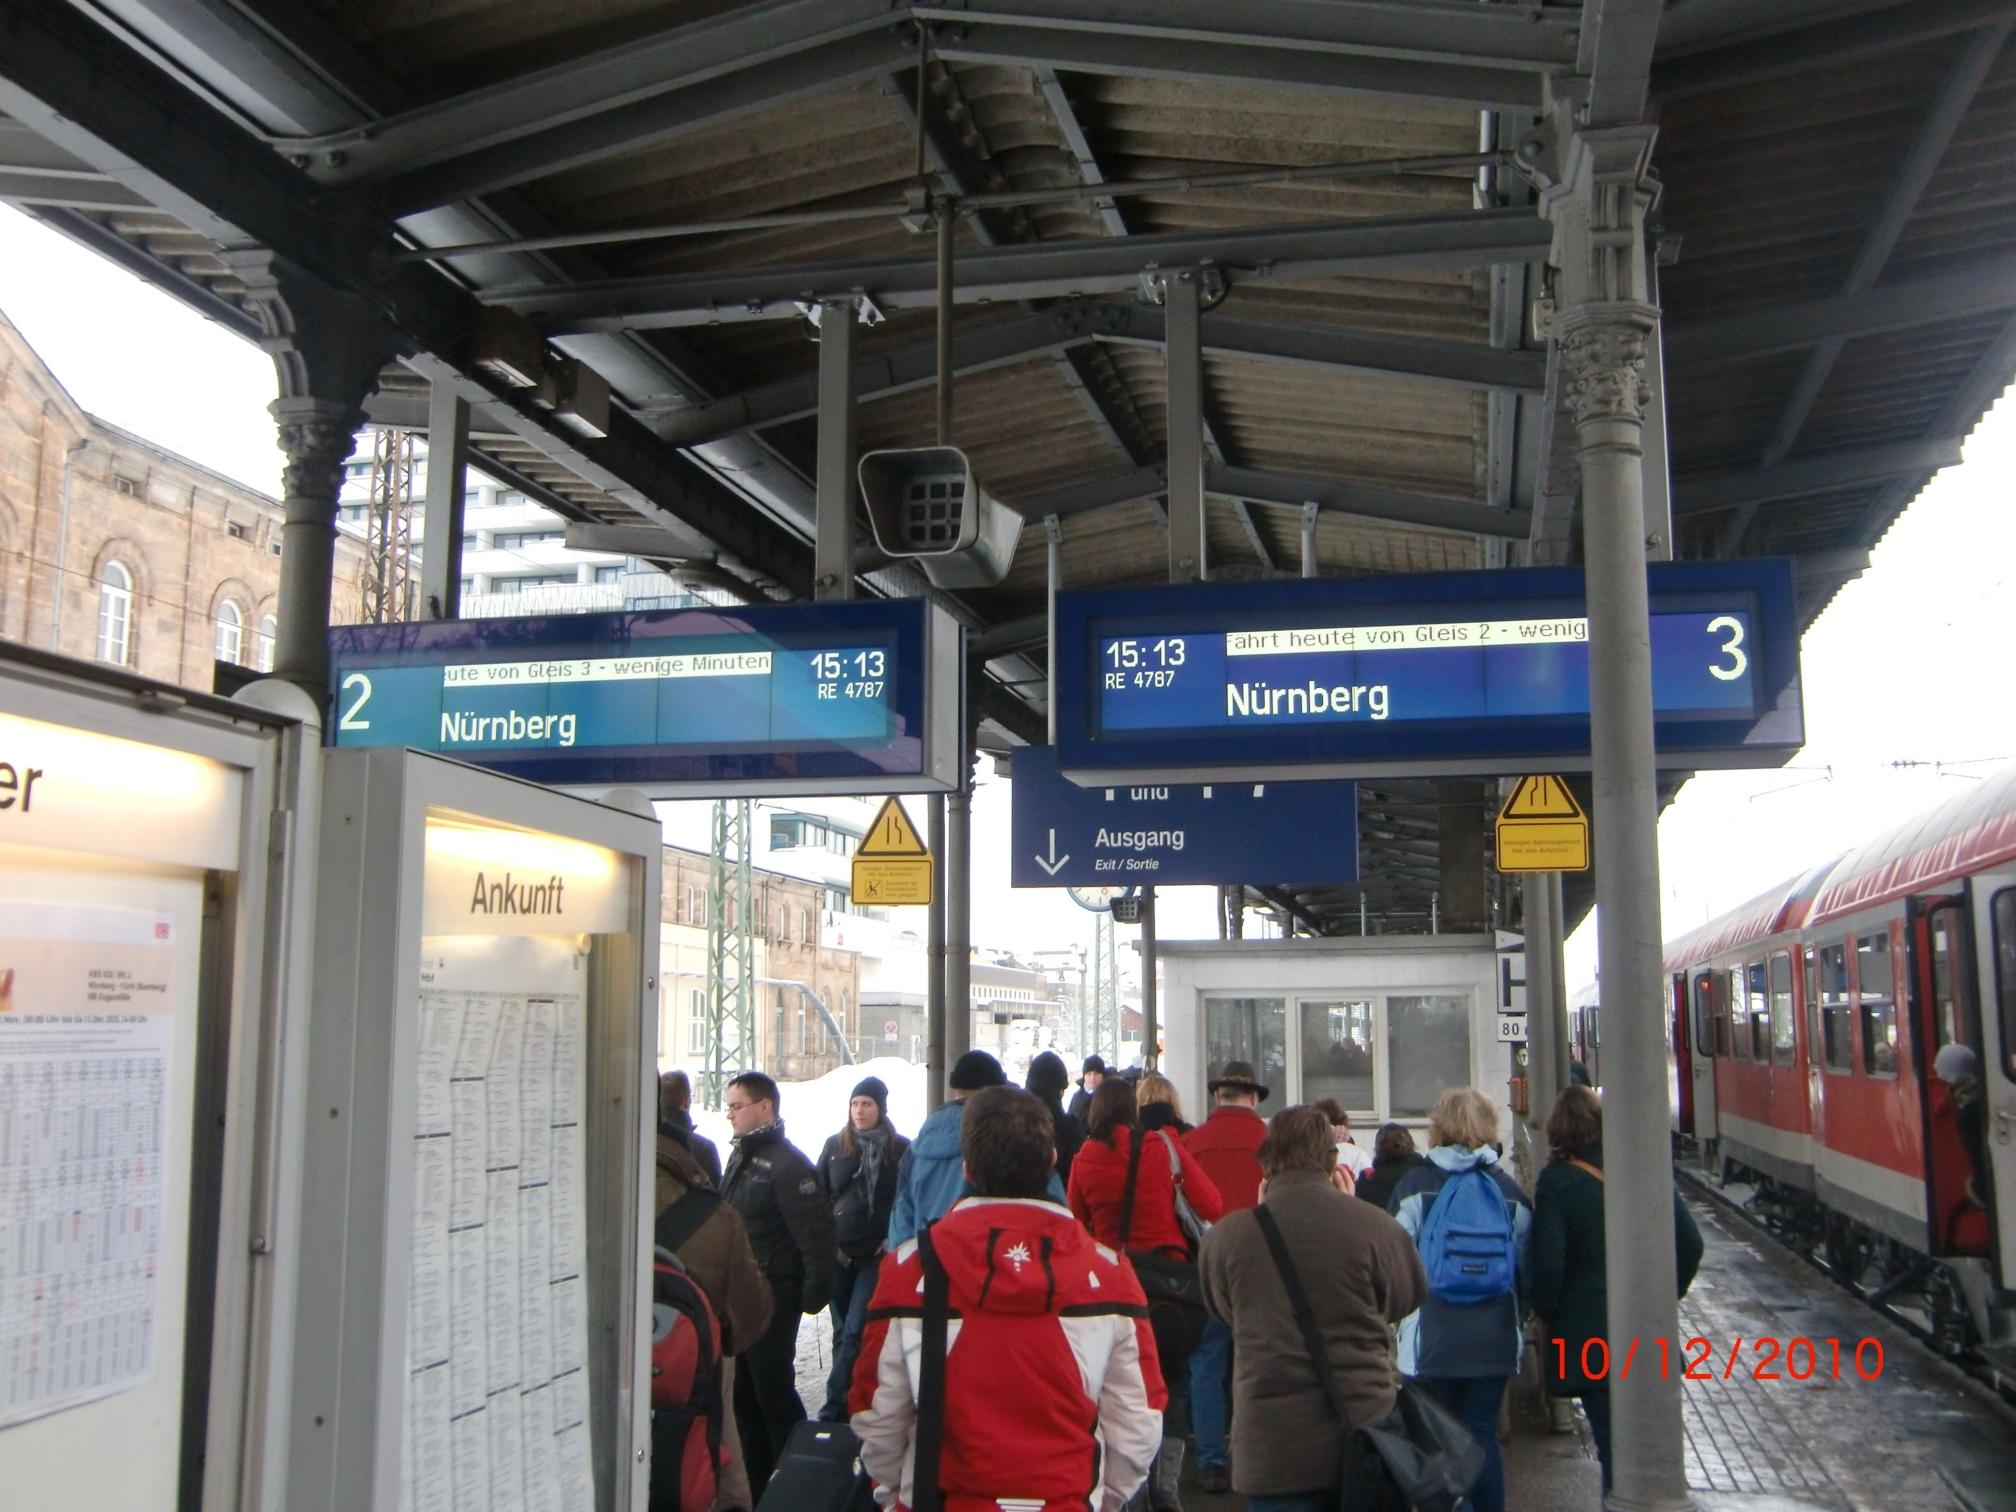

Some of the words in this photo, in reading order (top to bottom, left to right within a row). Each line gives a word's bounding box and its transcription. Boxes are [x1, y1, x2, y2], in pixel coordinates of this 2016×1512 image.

[1290, 629, 1355, 646] heute
[1366, 630, 1405, 644] von
[1415, 626, 1468, 641] Gleis
[1479, 623, 1491, 640] 2
[1706, 616, 1747, 681] 3
[487, 665, 519, 680] von
[527, 662, 572, 679] Gleis
[580, 661, 591, 677] 3
[613, 657, 684, 677] wenige
[692, 652, 770, 671] Minuten
[810, 651, 885, 679] 15:13
[1106, 639, 1186, 668] 15:13
[818, 683, 838, 700] RE
[845, 681, 884, 698] 4787
[1105, 673, 1126, 690] RE
[1134, 670, 1175, 689] 4787
[340, 673, 372, 730] 2
[1226, 680, 1389, 720] Nürnberg
[440, 709, 577, 746] Nürnberg
[1094, 827, 1185, 851] Ausgang
[1095, 859, 1116, 871] Exit
[1126, 858, 1160, 871] Sortie
[471, 871, 564, 915] Ankunft
[1502, 1022, 1520, 1037] 80
